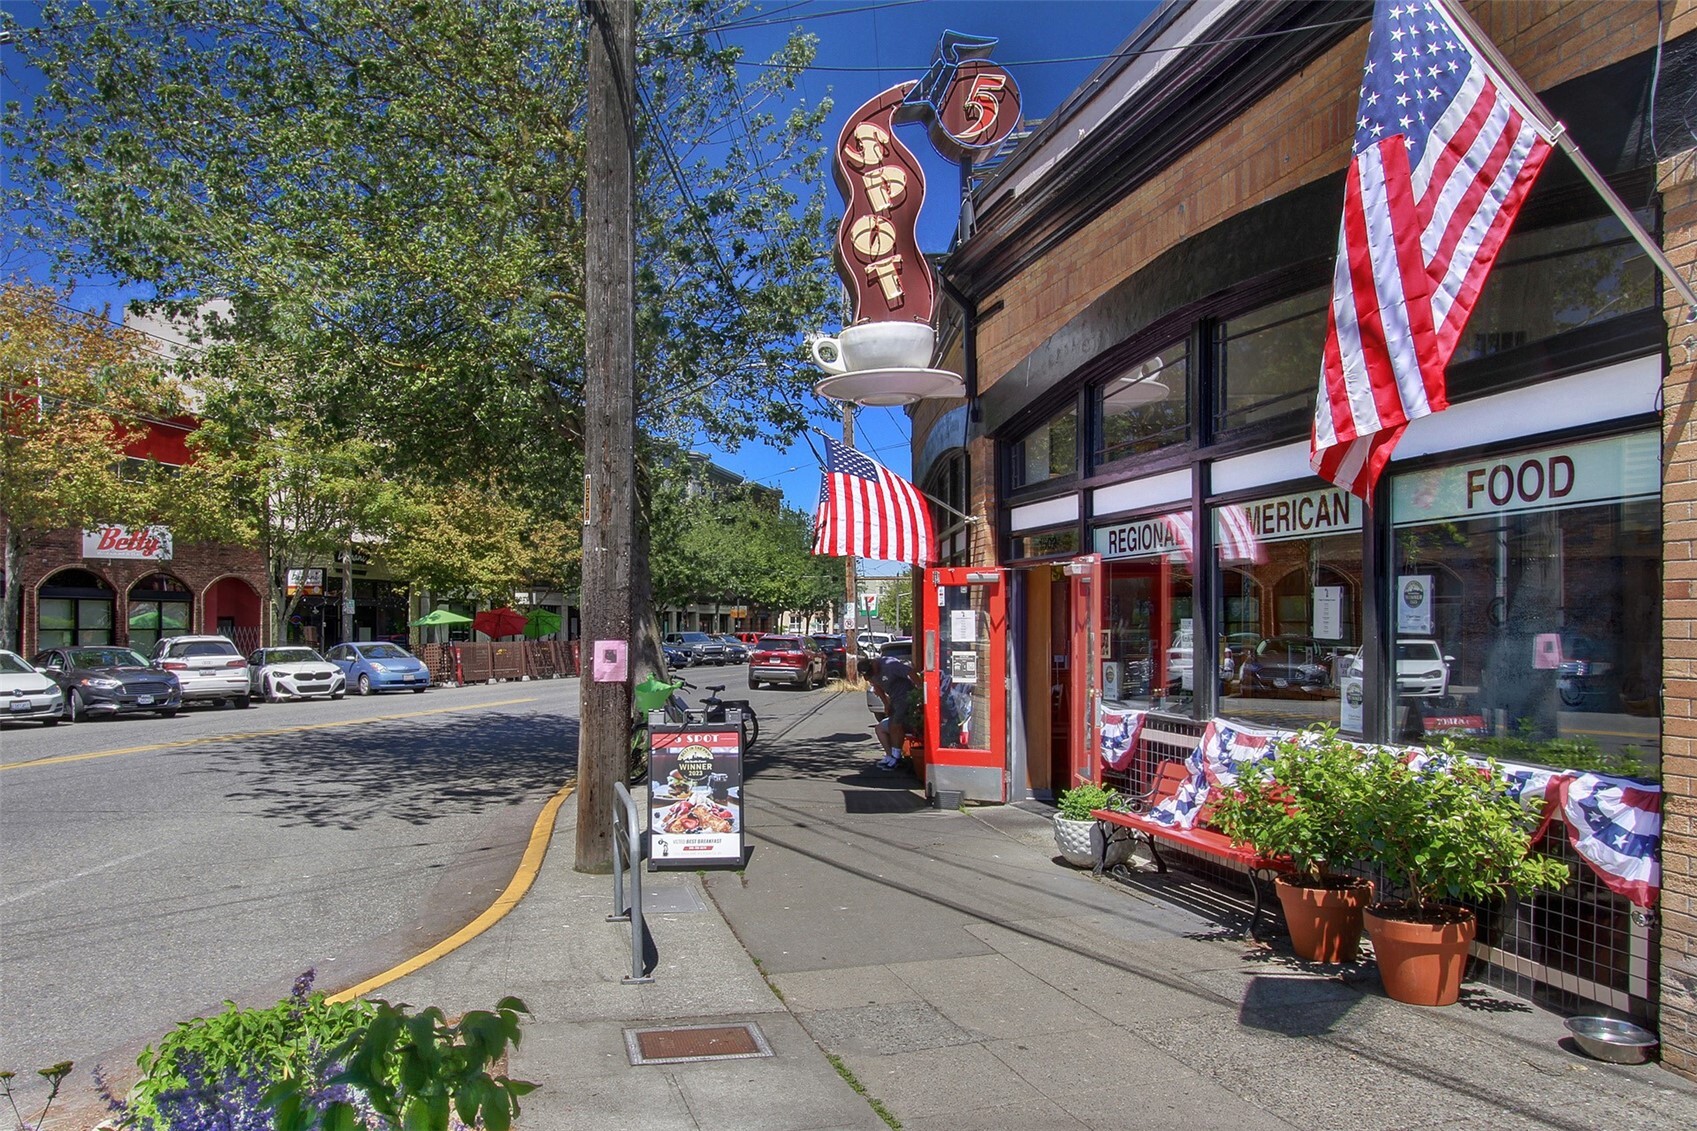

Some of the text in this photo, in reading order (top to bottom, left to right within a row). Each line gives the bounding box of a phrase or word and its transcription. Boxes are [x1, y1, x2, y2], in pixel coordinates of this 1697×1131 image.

[956, 73, 1006, 139] 5
[845, 121, 908, 302] SPOT
[1466, 454, 1575, 510] FOOD
[1245, 491, 1350, 536] MERICAN
[97, 527, 159, 557] Betty
[674, 734, 720, 743] 5 SPOT
